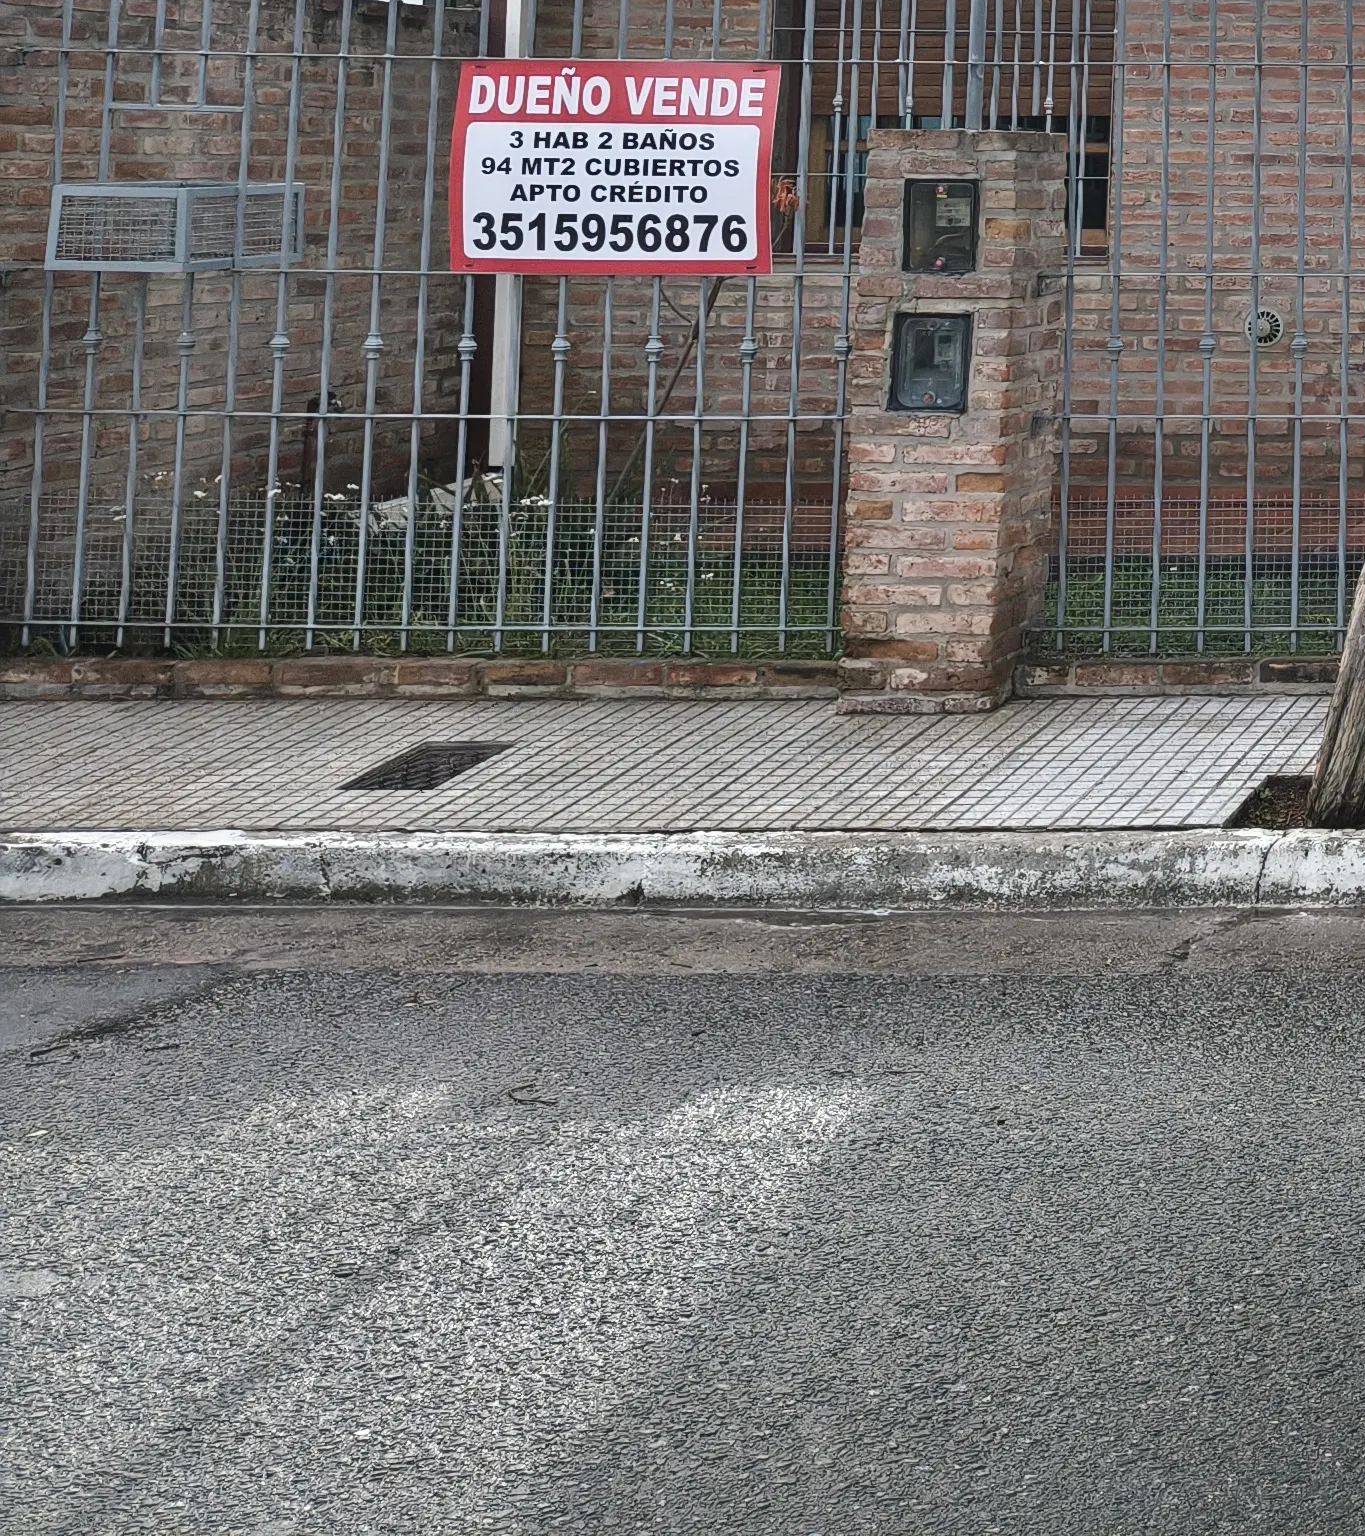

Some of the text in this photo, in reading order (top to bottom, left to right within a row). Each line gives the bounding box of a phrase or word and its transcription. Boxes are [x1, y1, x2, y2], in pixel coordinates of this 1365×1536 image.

[468, 67, 767, 117] DUEÑO VENDE
[509, 129, 715, 151] 3 HAB 2 BAÑOS
[481, 157, 740, 177] 94 MT2 CUBIERTOS
[510, 180, 708, 204] APTO CRÉDITO
[472, 212, 748, 253] 3515956876
